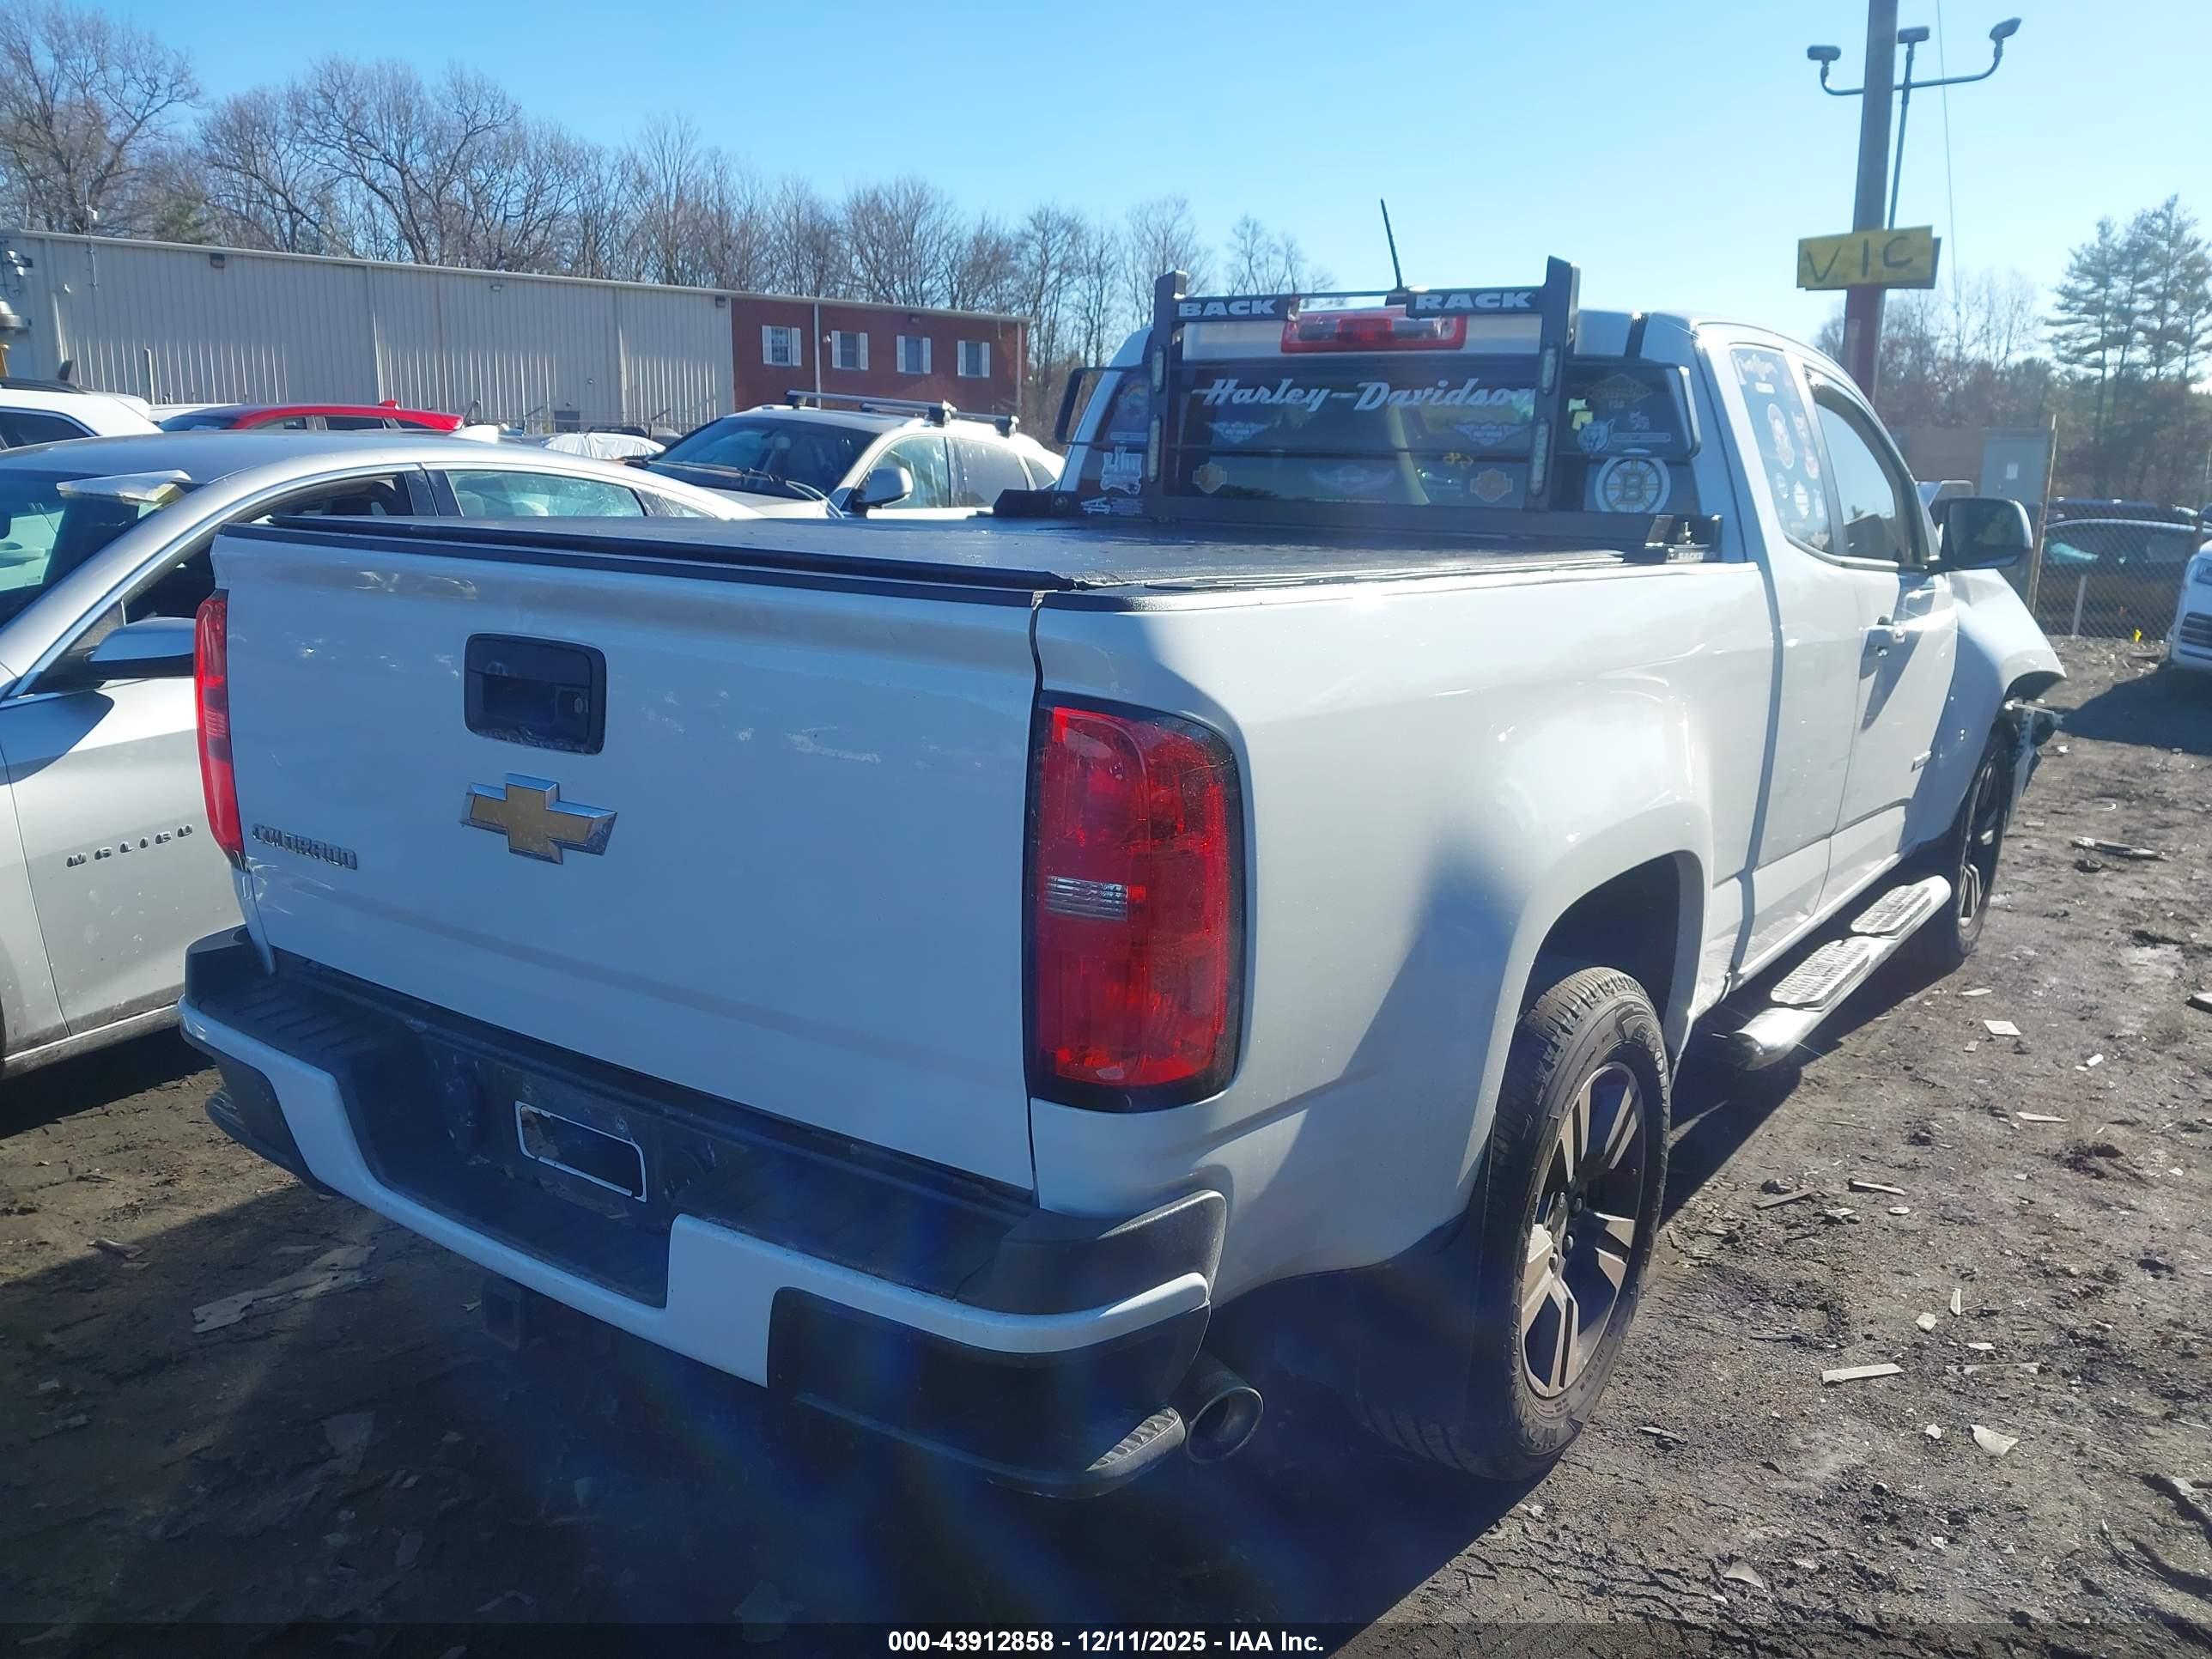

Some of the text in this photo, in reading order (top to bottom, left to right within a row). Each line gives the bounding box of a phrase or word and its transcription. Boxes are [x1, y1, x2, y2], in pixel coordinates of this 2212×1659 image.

[1807, 236, 1914, 283] VIC
[1178, 291, 1532, 317] BACK RACK
[65, 823, 194, 868] MALIBU
